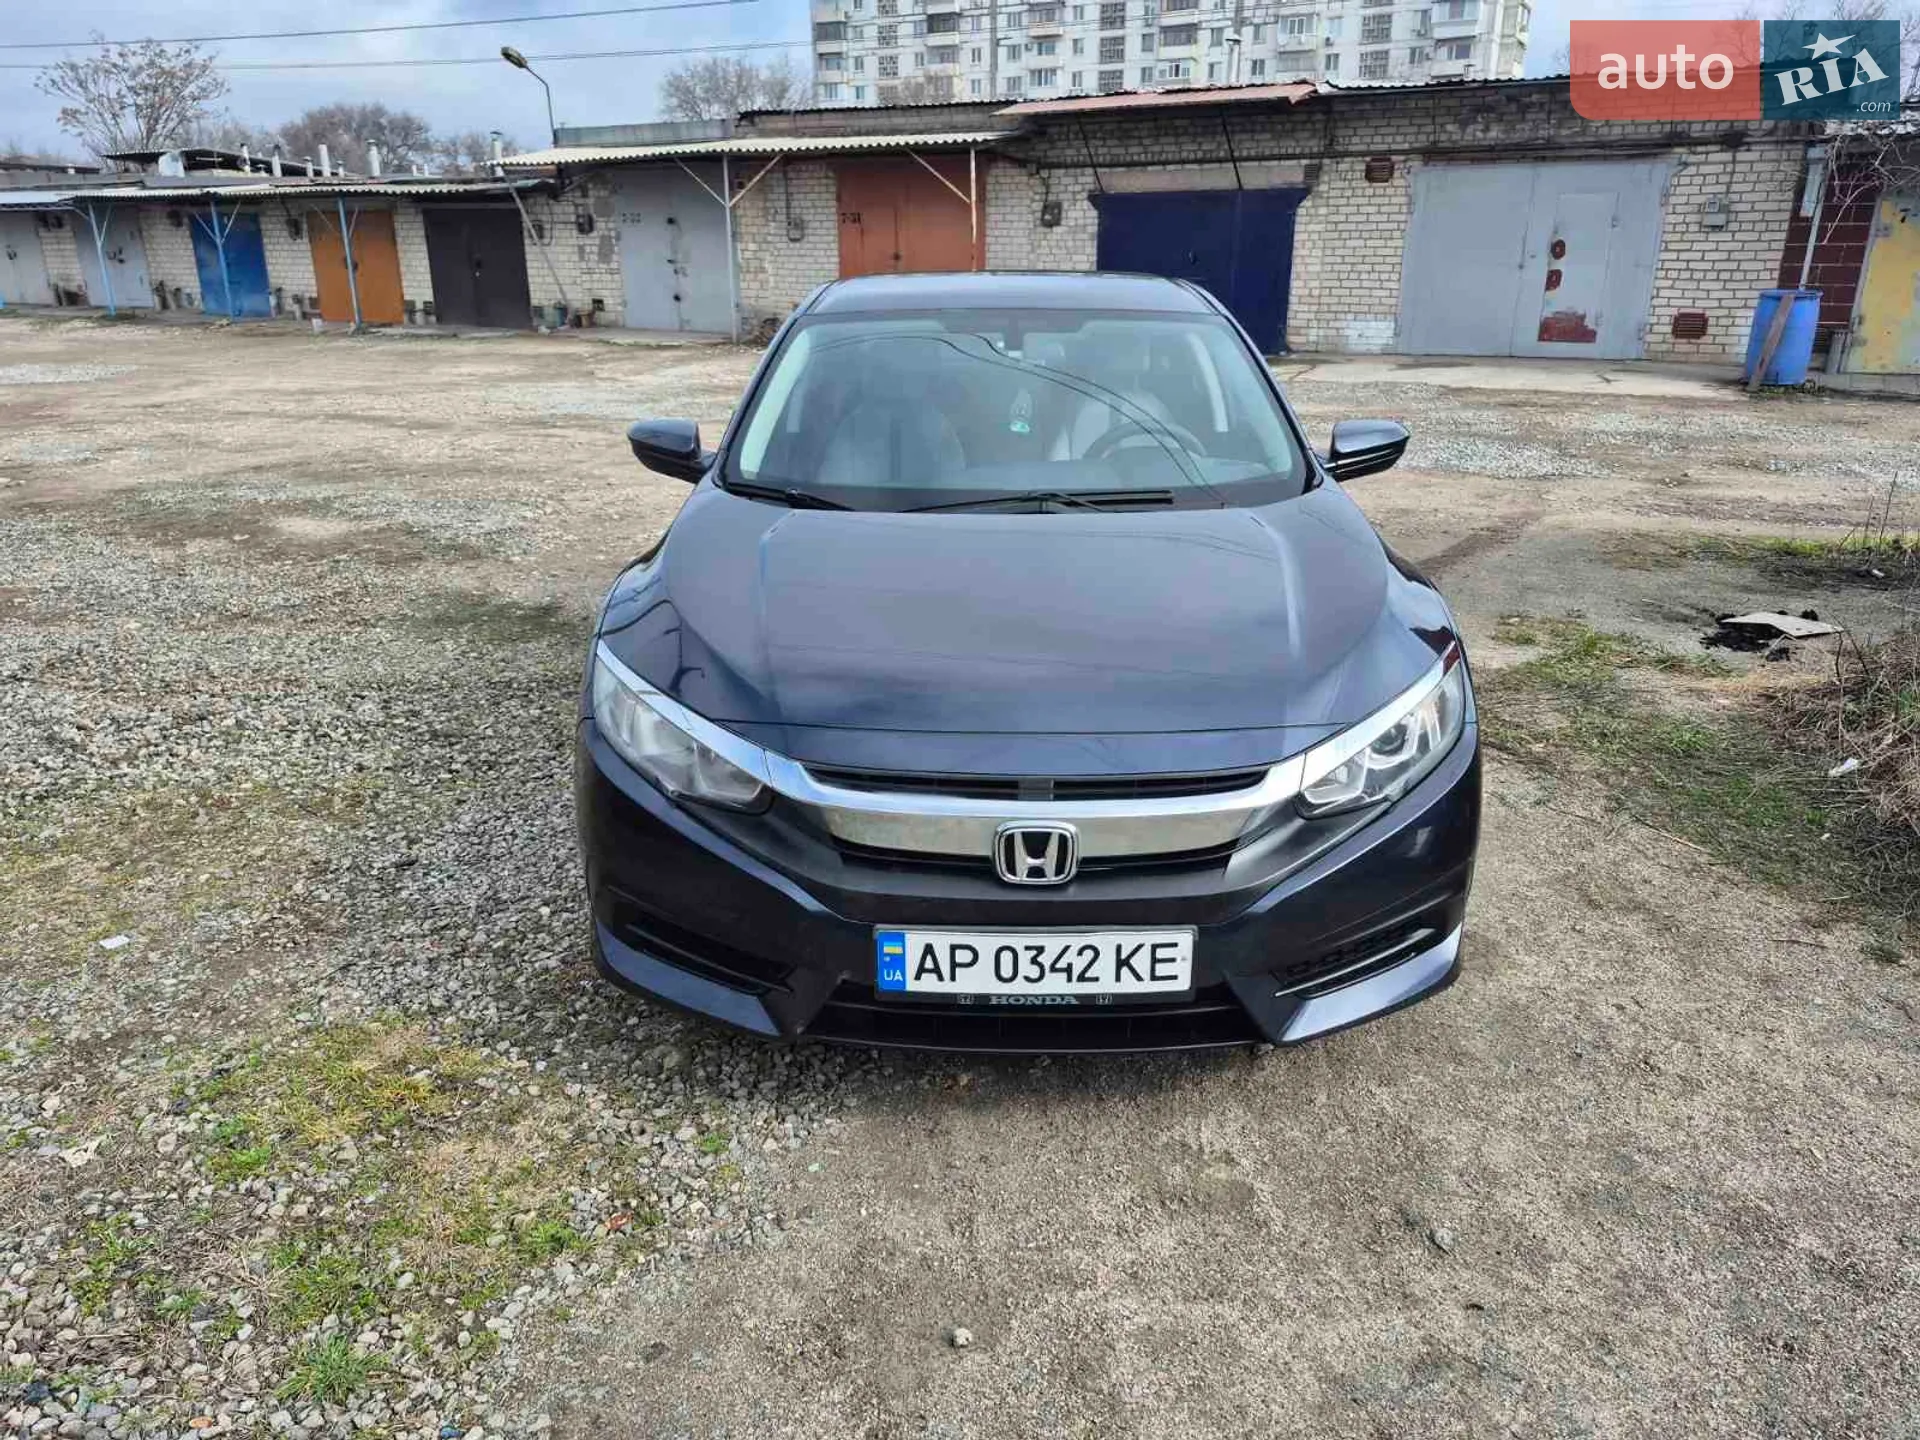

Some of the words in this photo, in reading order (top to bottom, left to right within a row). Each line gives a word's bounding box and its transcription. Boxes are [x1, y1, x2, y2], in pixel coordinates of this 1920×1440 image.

[914, 943, 980, 982] AP
[994, 944, 1100, 983] 0342
[1114, 942, 1179, 982] KE
[884, 968, 903, 981] UA
[989, 995, 1079, 1005] HONDA
